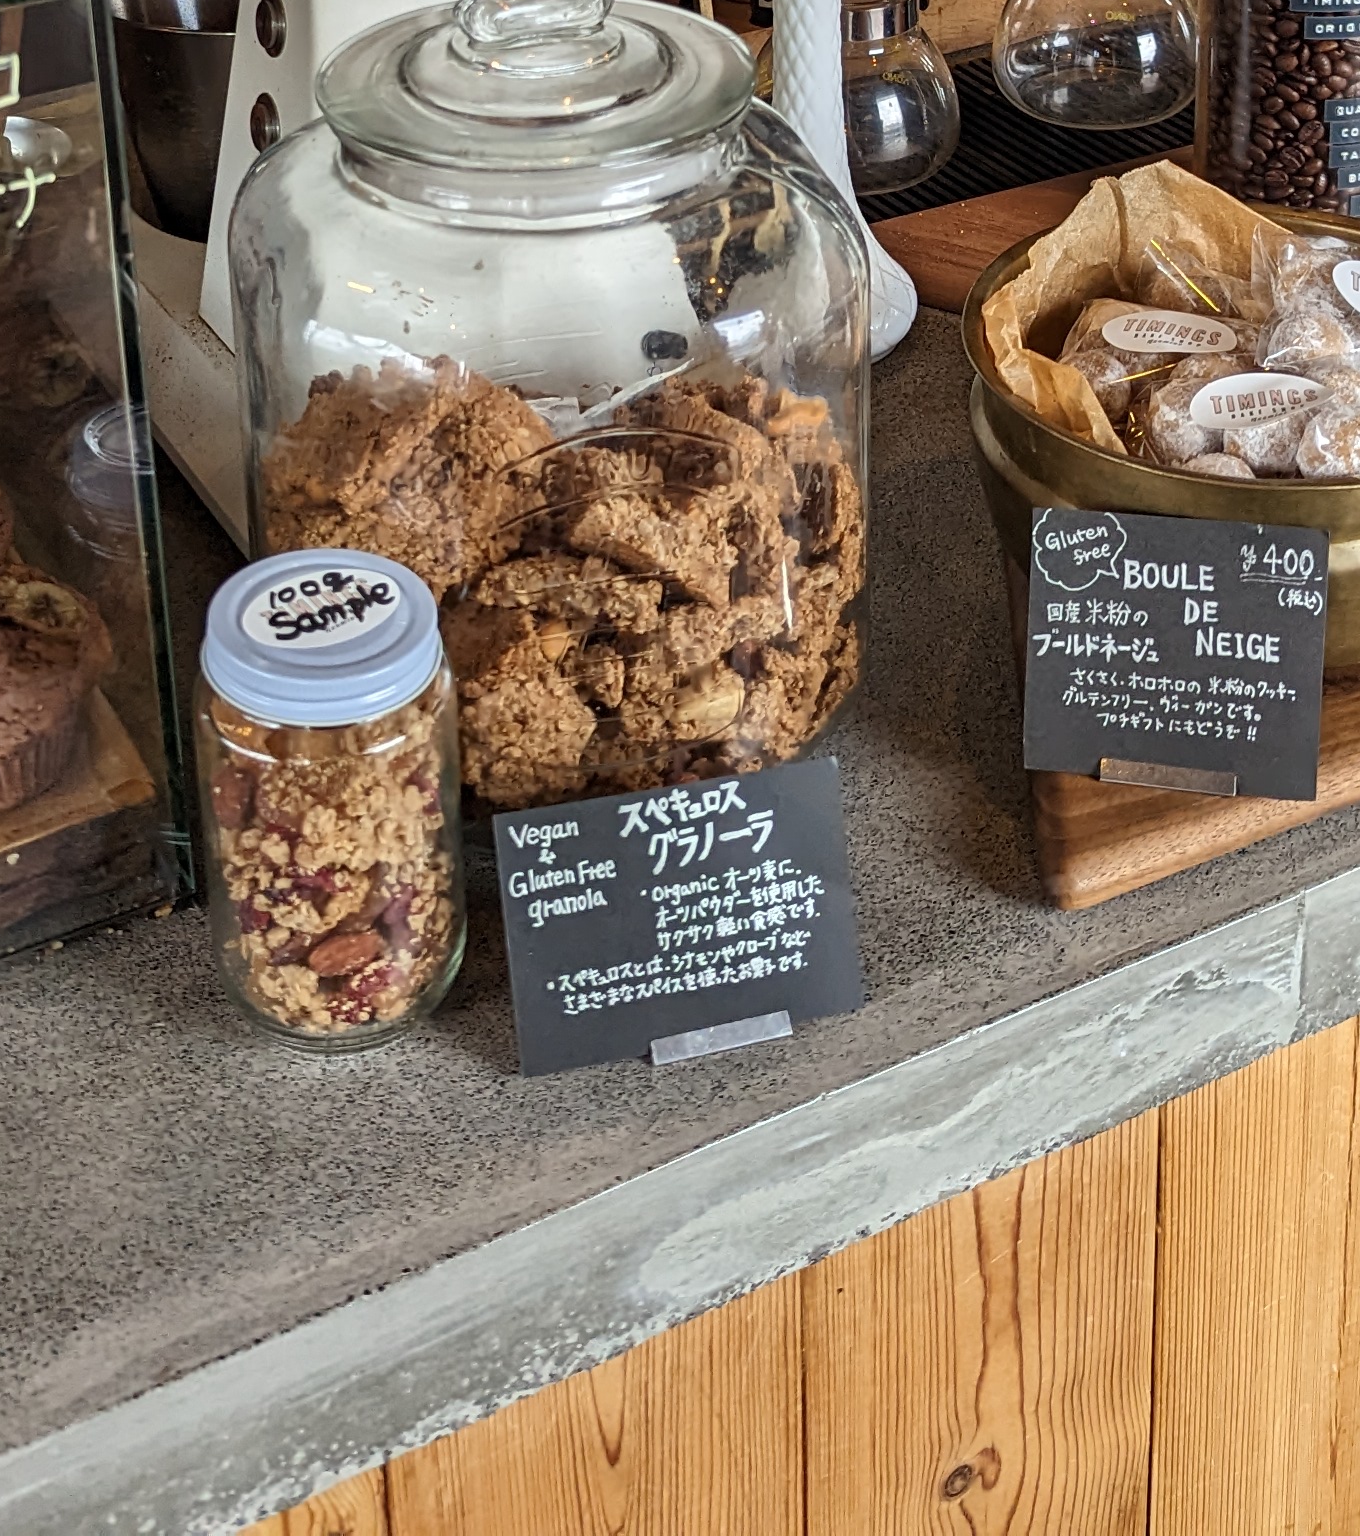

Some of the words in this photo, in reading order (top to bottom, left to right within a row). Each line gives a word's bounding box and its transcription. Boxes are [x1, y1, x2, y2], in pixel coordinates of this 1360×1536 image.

[1123, 318, 1222, 346] TIMINGS
[1209, 388, 1319, 415] TIMINGS
[1044, 523, 1109, 552] Gluten
[1072, 542, 1112, 566] free
[1122, 557, 1216, 592] BOULE
[268, 582, 396, 641] Sample
[1046, 597, 1149, 627] 国産米粉の
[1183, 597, 1220, 627] DE
[1032, 628, 1161, 664] ブールドネージュ
[1195, 626, 1282, 665] NEIGE
[617, 779, 748, 839] スペキュロス
[507, 819, 581, 850] Vegan
[647, 809, 775, 876] グラノーラ
[507, 868, 576, 900] Gluten
[577, 857, 618, 886] Free
[527, 888, 610, 929] granola
